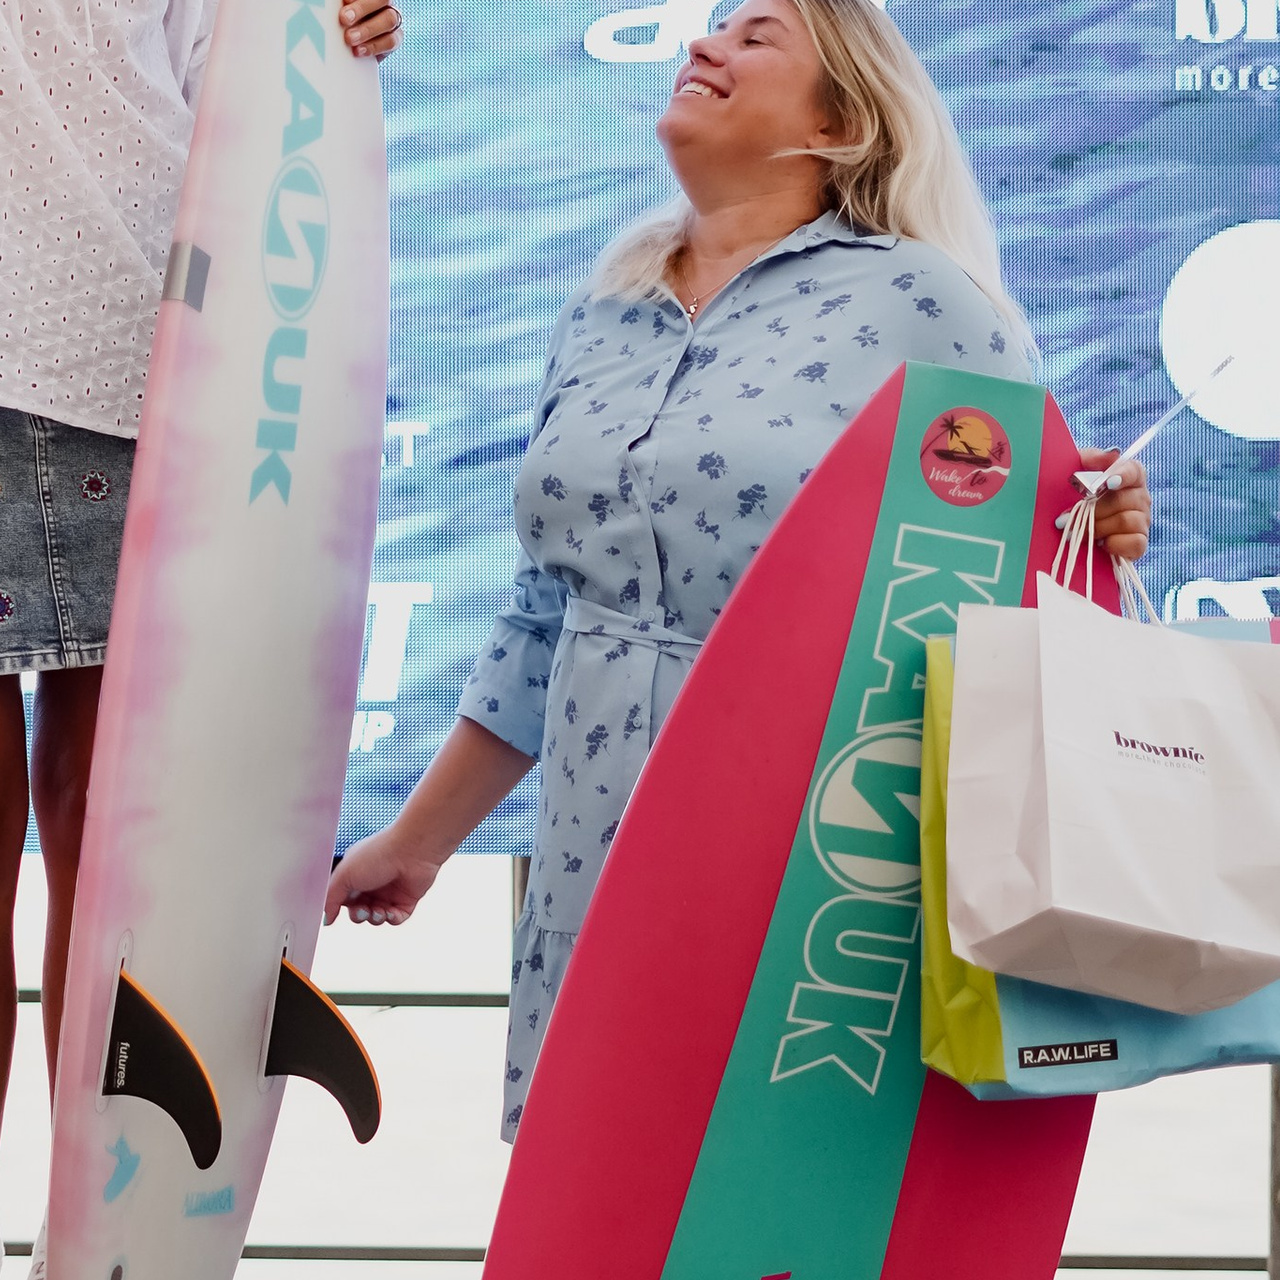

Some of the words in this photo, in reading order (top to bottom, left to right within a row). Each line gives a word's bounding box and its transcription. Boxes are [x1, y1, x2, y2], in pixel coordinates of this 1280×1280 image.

[948, 485, 983, 500] dream
[1112, 730, 1206, 765] brownie
[116, 1042, 130, 1088] futures.
[1023, 1043, 1112, 1064] R.A.W.LIFE
